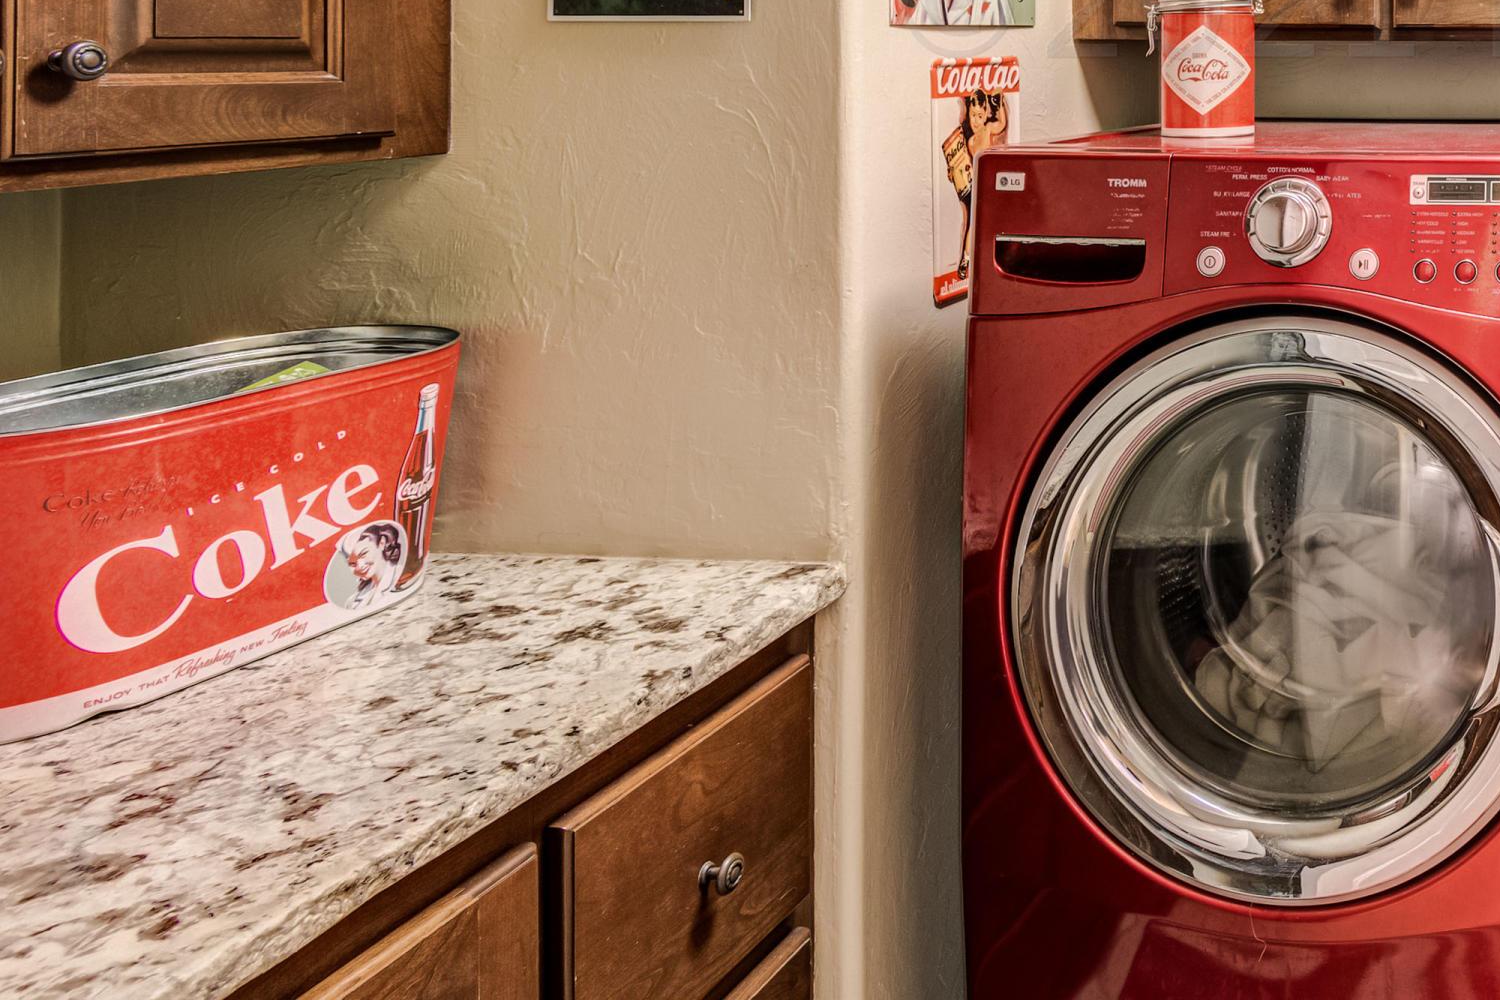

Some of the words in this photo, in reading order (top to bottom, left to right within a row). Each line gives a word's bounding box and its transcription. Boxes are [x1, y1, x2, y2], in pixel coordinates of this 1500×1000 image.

[1177, 57, 1229, 82] Coca-Cola
[1010, 178, 1021, 186] LG
[1107, 178, 1147, 187] TROMM
[187, 481, 245, 516] ICE
[269, 430, 347, 475] COLD
[55, 463, 383, 654] Coke
[83, 688, 132, 708] ENJOY
[138, 674, 170, 691] THAT
[172, 647, 238, 680] Refreshing
[240, 639, 265, 652] NEW
[267, 620, 308, 644] Feeling
